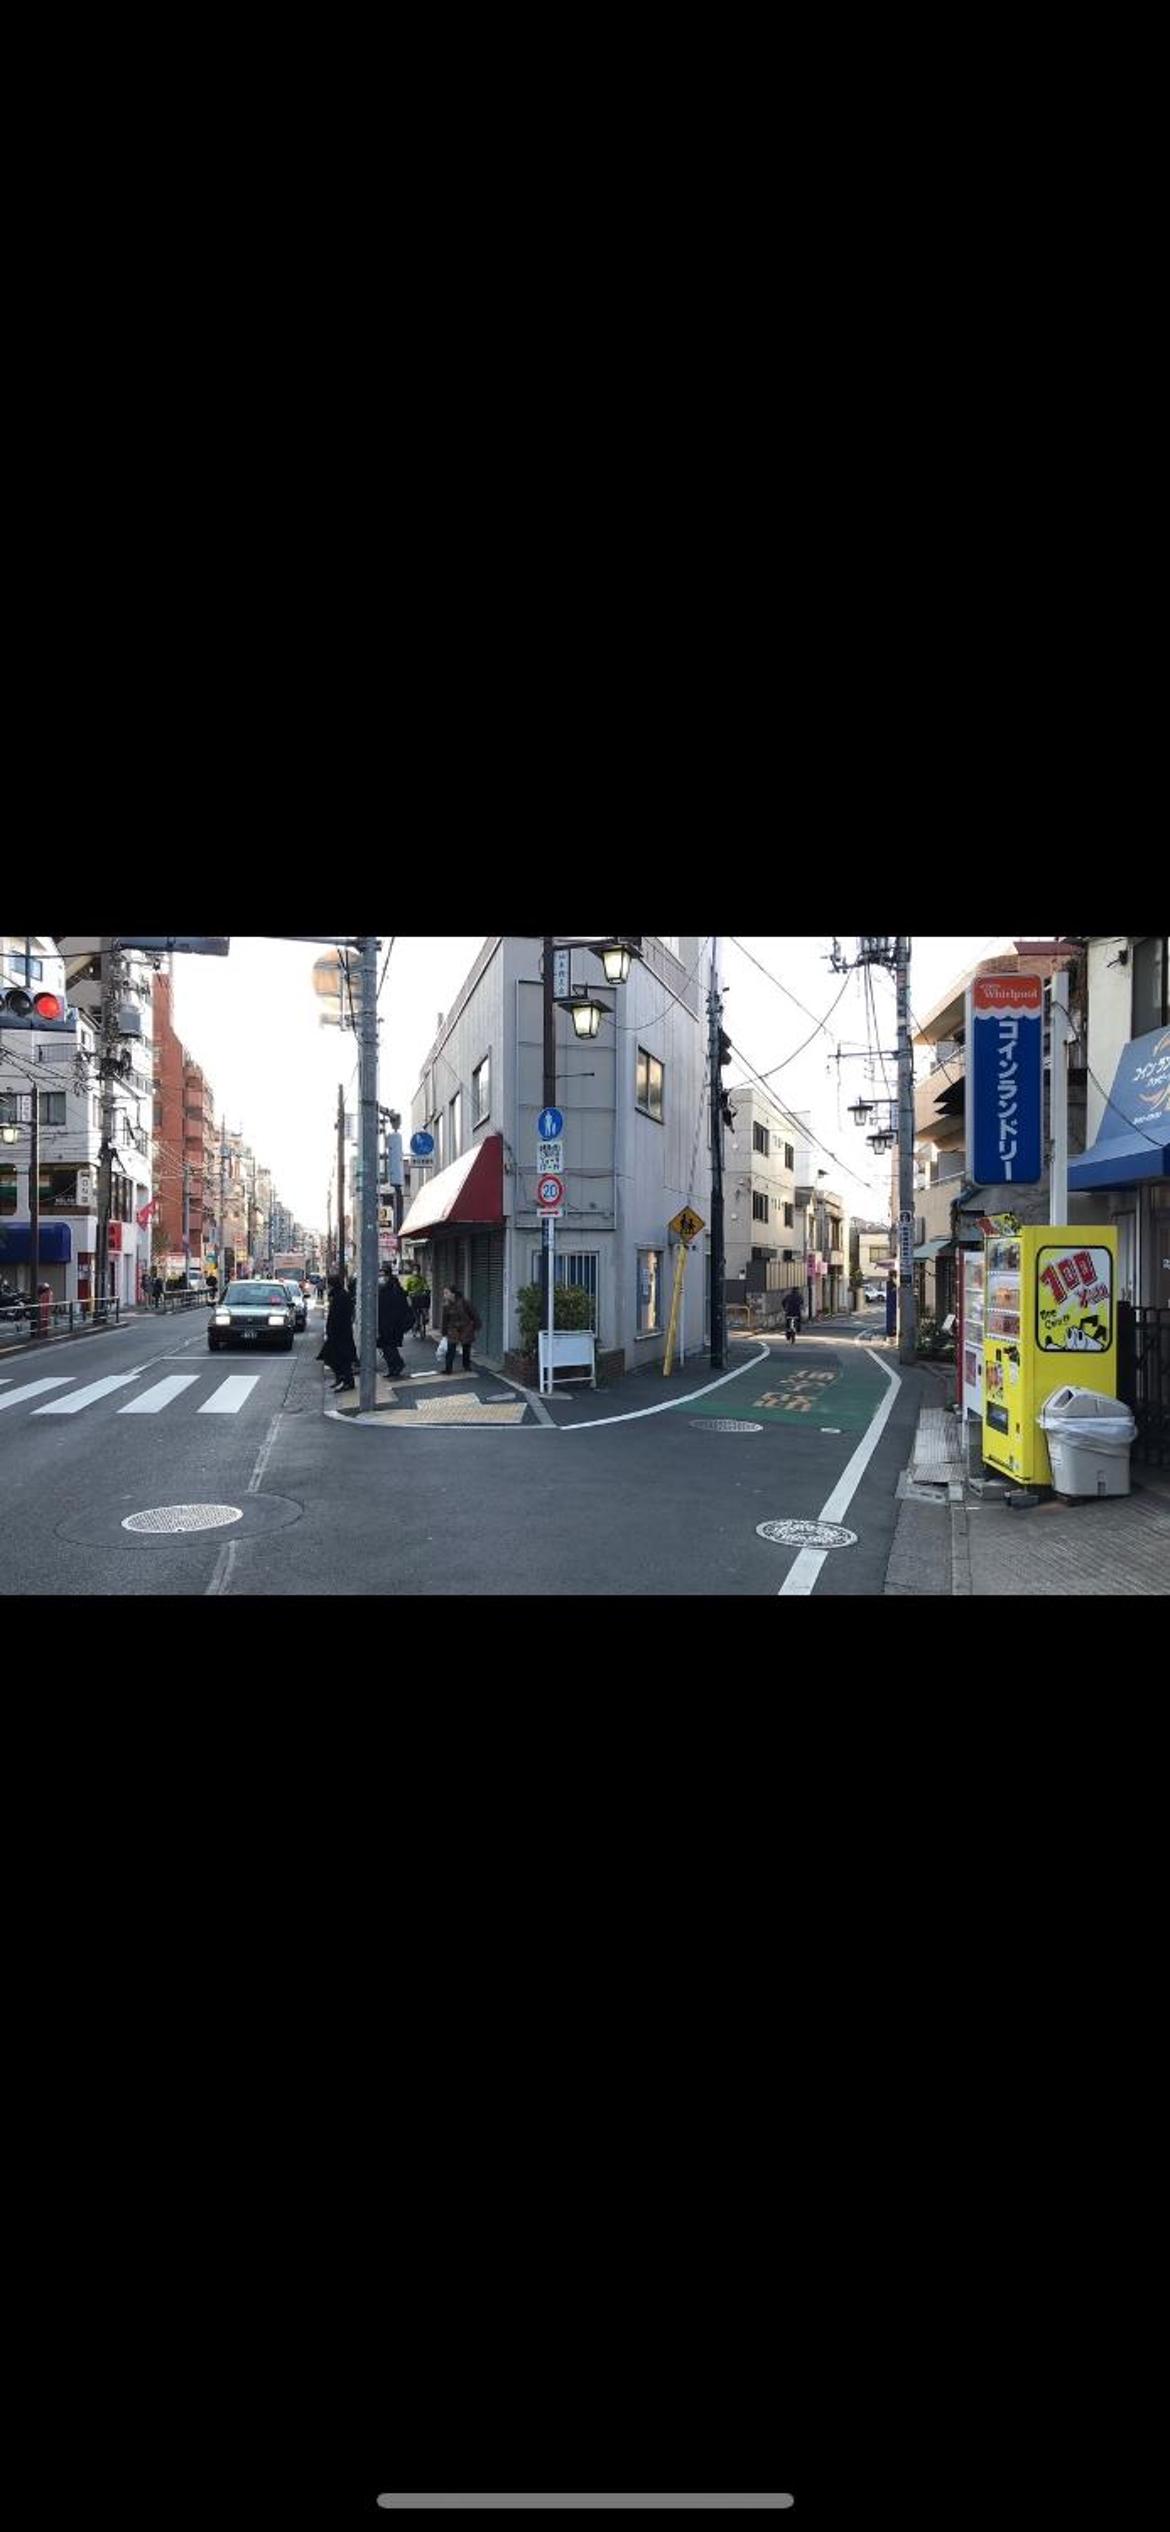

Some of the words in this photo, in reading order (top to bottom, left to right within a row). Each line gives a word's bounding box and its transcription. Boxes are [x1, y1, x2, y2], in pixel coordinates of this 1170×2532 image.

[998, 1020, 1018, 1181] コインランドリー
[543, 1184, 558, 1198] 20
[1040, 1250, 1098, 1305] 100
